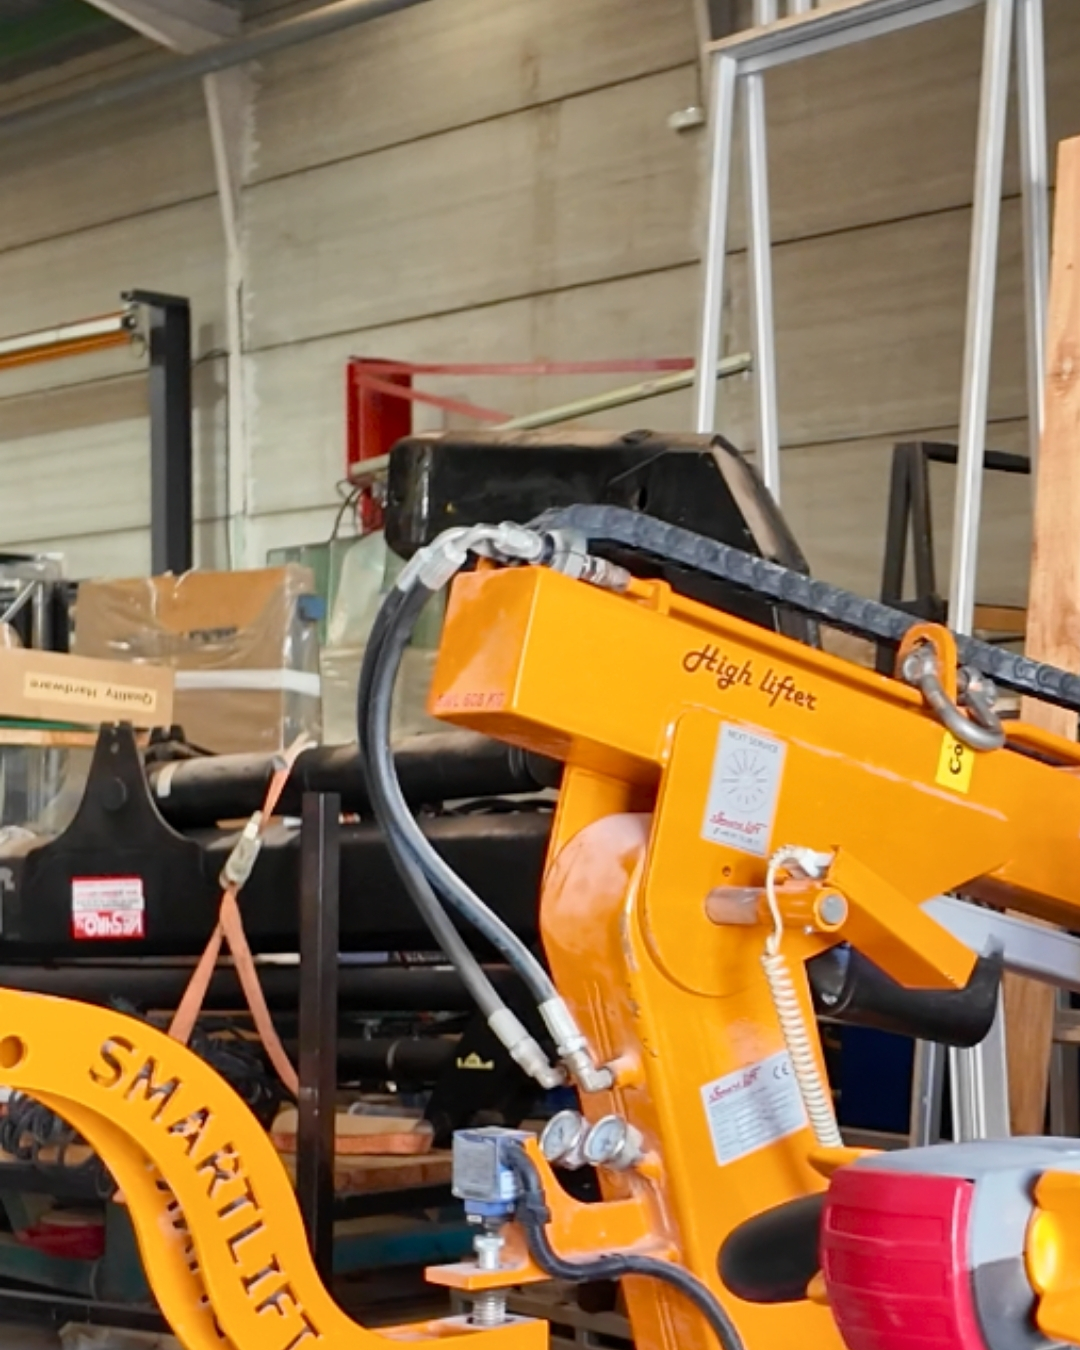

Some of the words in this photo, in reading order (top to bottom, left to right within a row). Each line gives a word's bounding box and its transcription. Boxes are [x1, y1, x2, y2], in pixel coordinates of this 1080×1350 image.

[682, 643, 752, 690] High
[759, 668, 817, 711] lifter
[29, 678, 98, 699] Hardware
[105, 686, 153, 706] Quality
